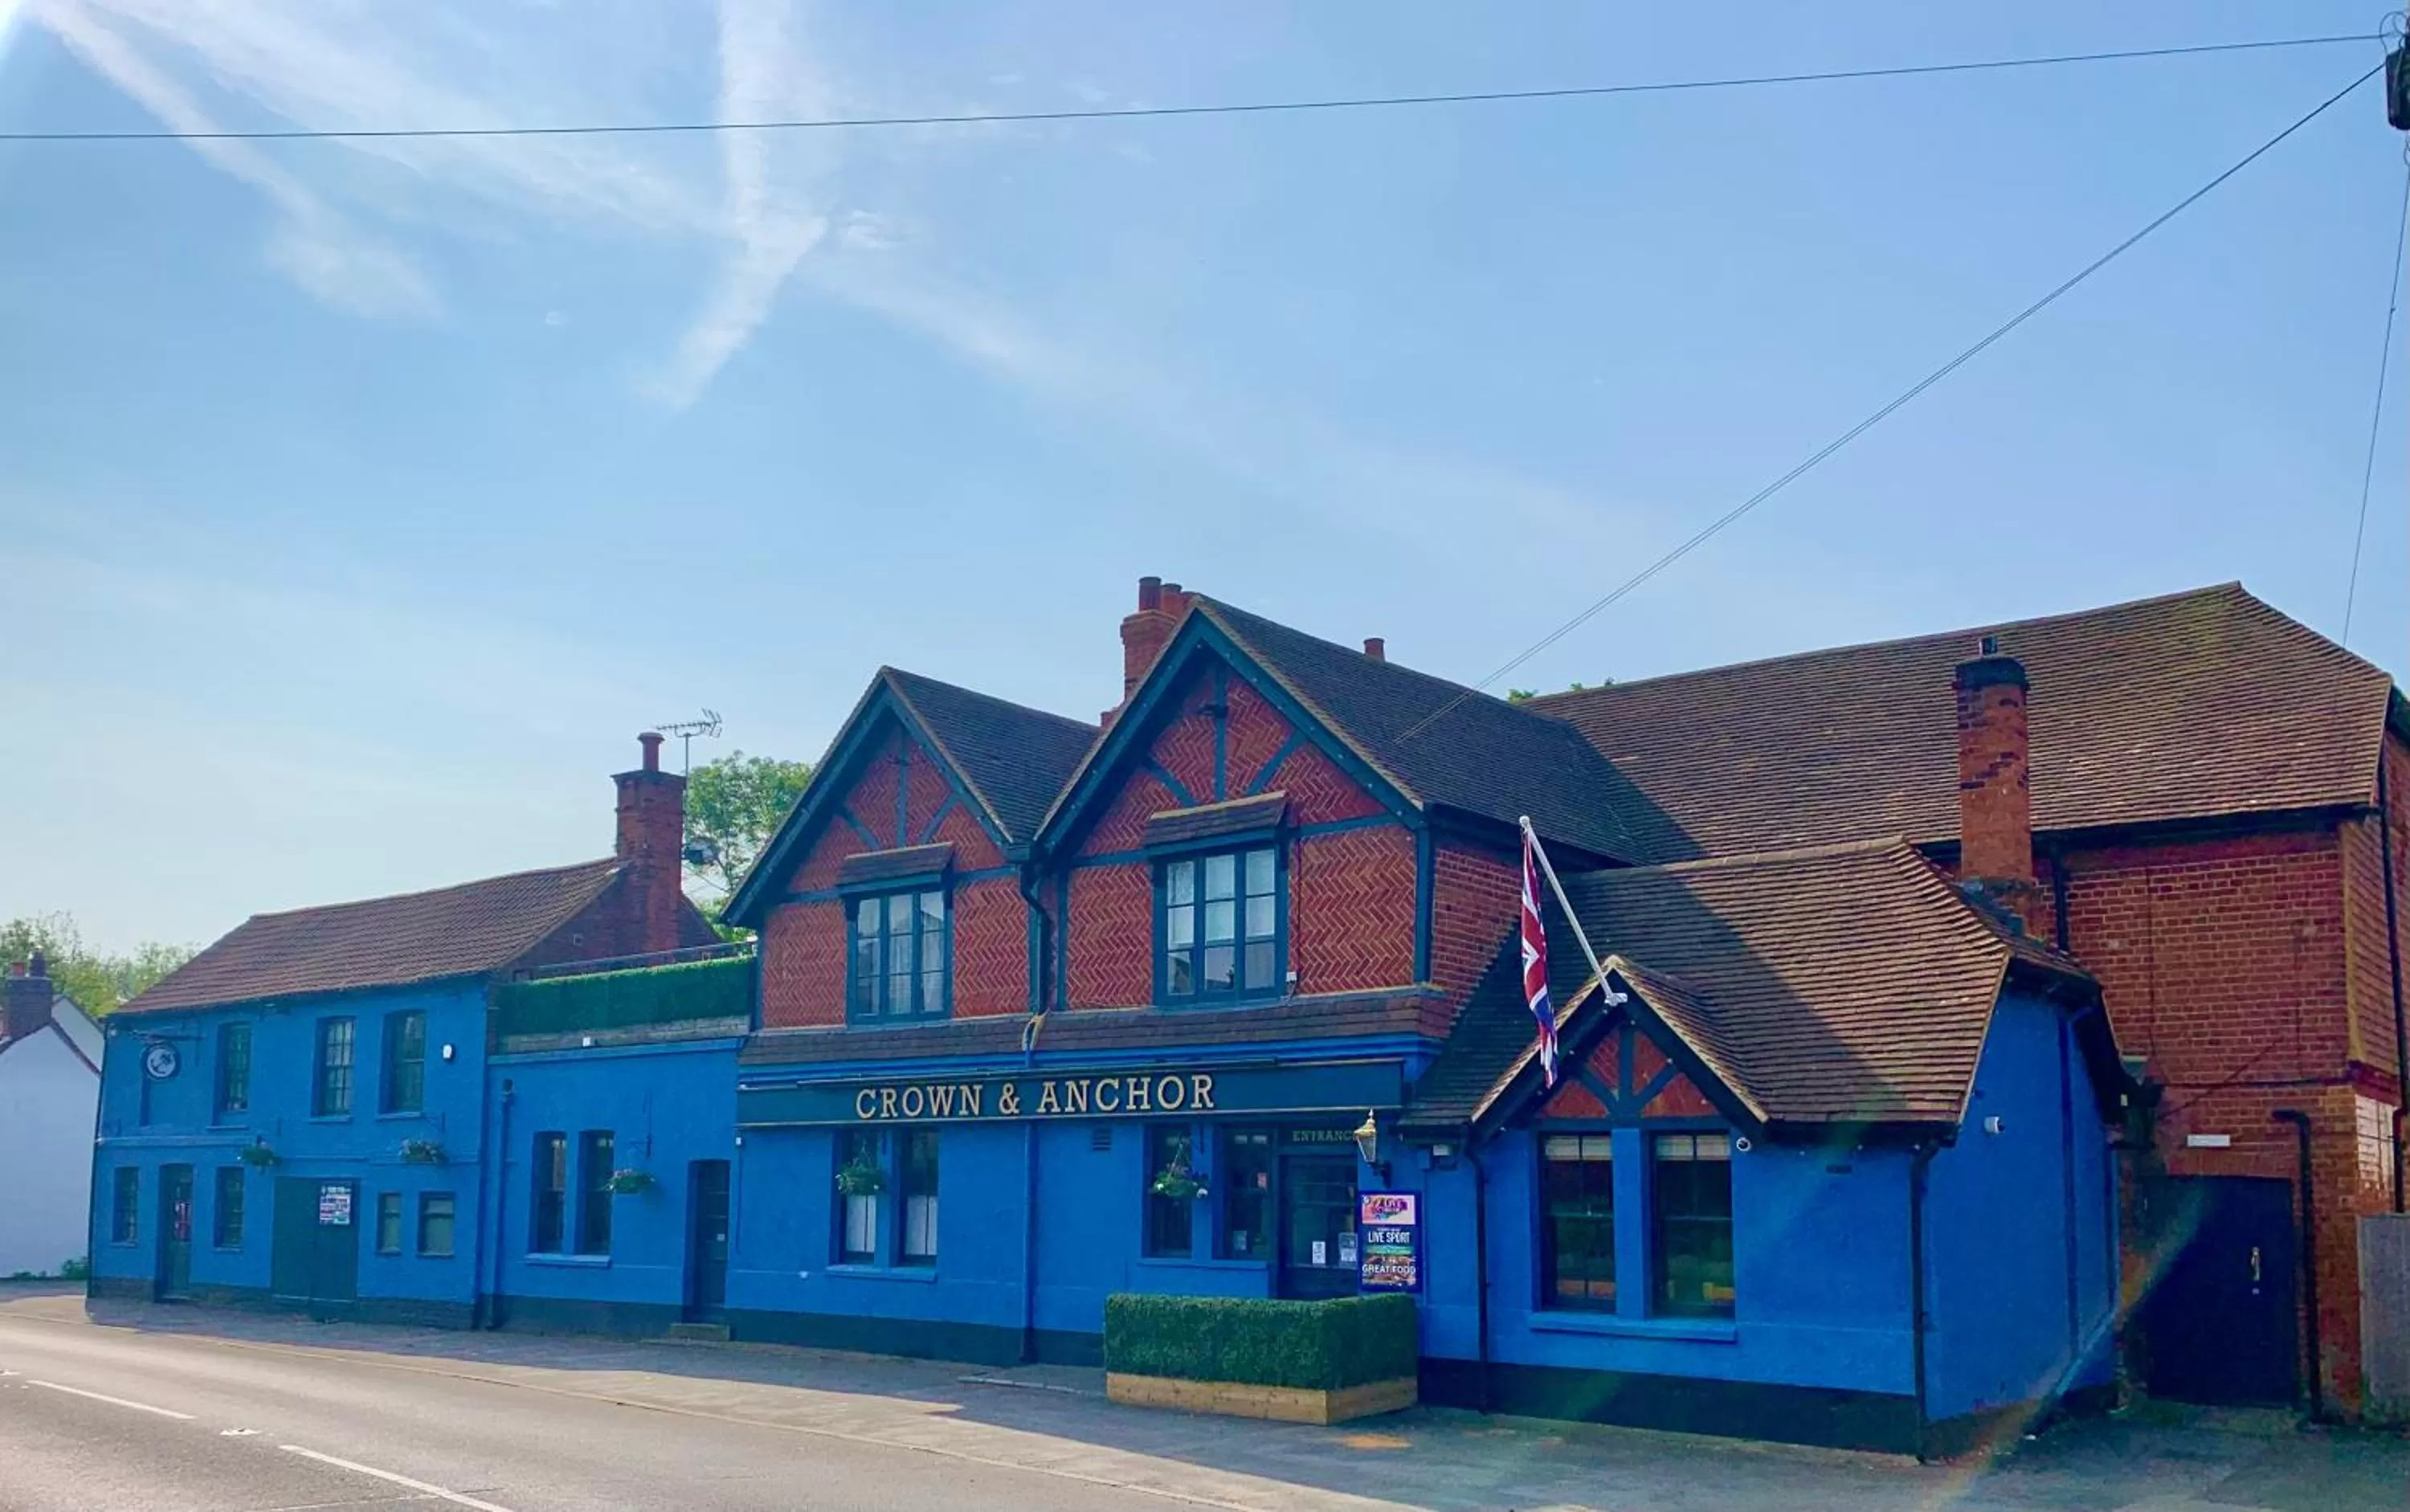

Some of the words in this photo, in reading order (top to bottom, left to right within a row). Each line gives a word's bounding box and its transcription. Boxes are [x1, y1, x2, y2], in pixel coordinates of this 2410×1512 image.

[856, 1085, 982, 1119] CROWN
[999, 1083, 1019, 1115] &
[1036, 1075, 1215, 1114] ANCHOR
[1293, 1130, 1355, 1142] ENTRANC
[1368, 1231, 1384, 1243] LIVE
[1386, 1232, 1410, 1244] SPORT
[1362, 1264, 1390, 1273] GREAT
[1392, 1266, 1416, 1274] FOOD
